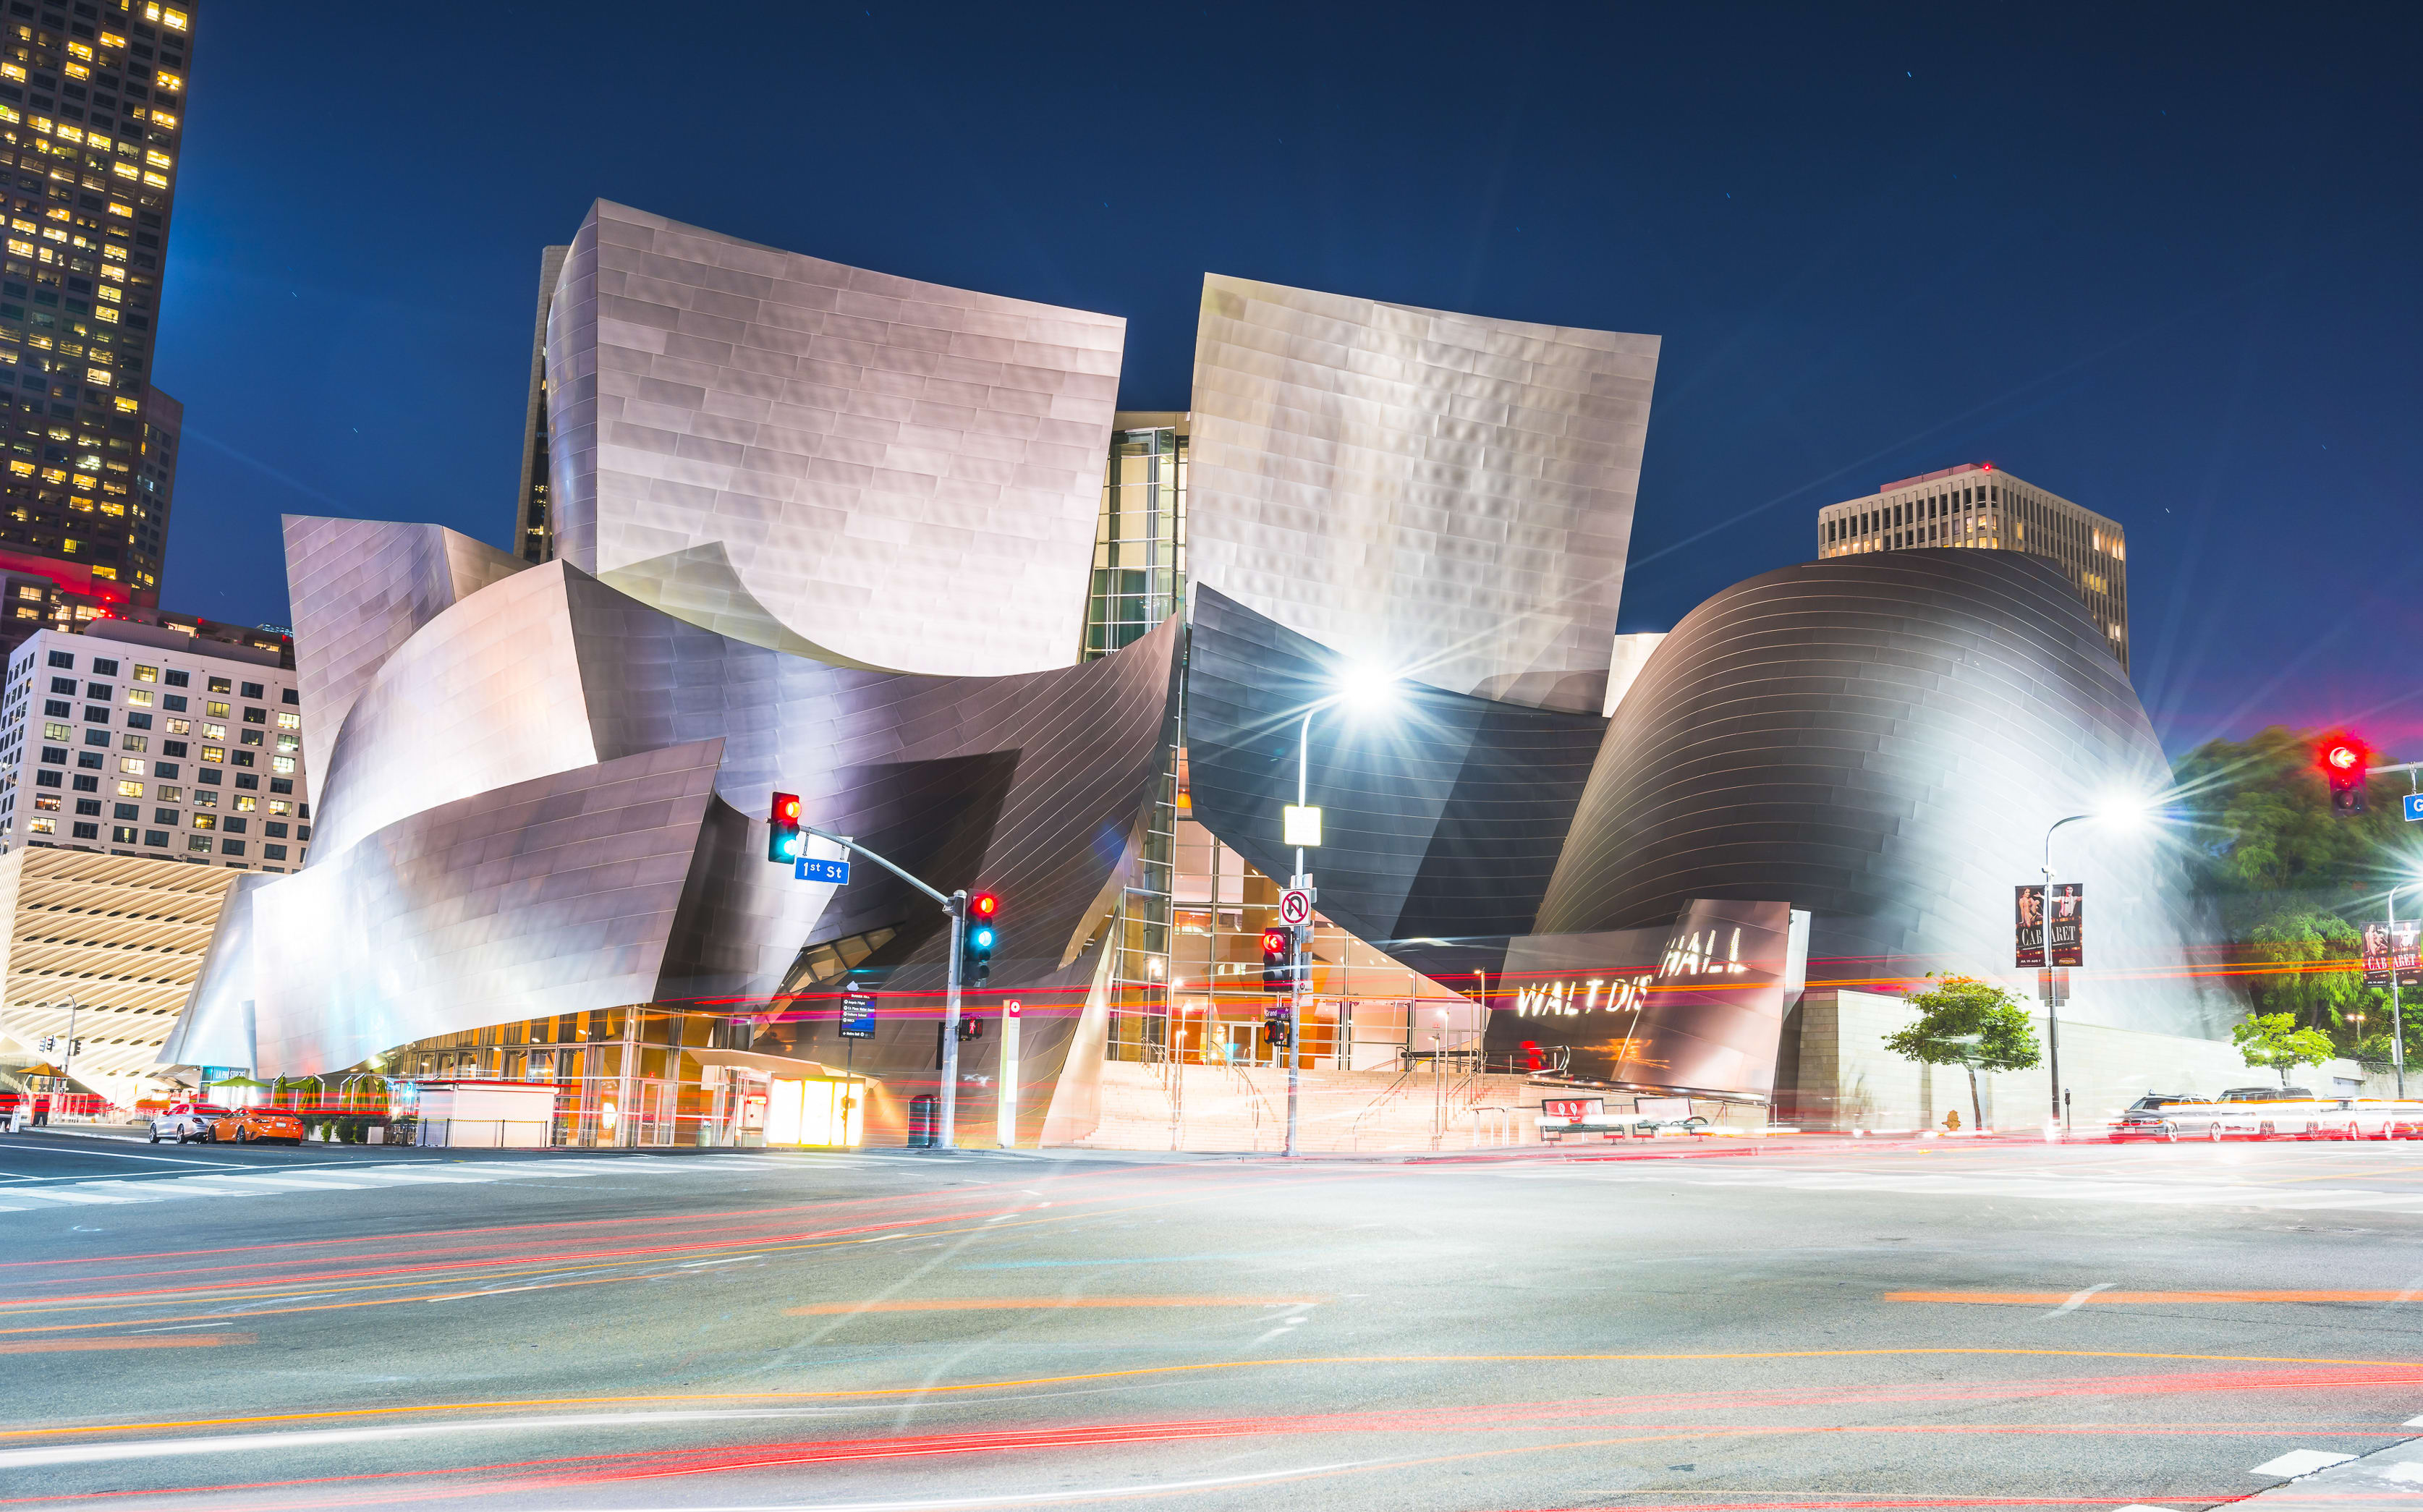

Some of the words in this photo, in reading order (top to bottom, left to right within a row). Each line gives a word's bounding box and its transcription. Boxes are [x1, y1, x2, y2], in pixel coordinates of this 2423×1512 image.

[803, 862, 820, 876] 1st
[826, 866, 841, 878] St
[1659, 927, 1747, 978] HALL
[2368, 954, 2415, 970] CABARET
[1516, 980, 1603, 1017] WALT
